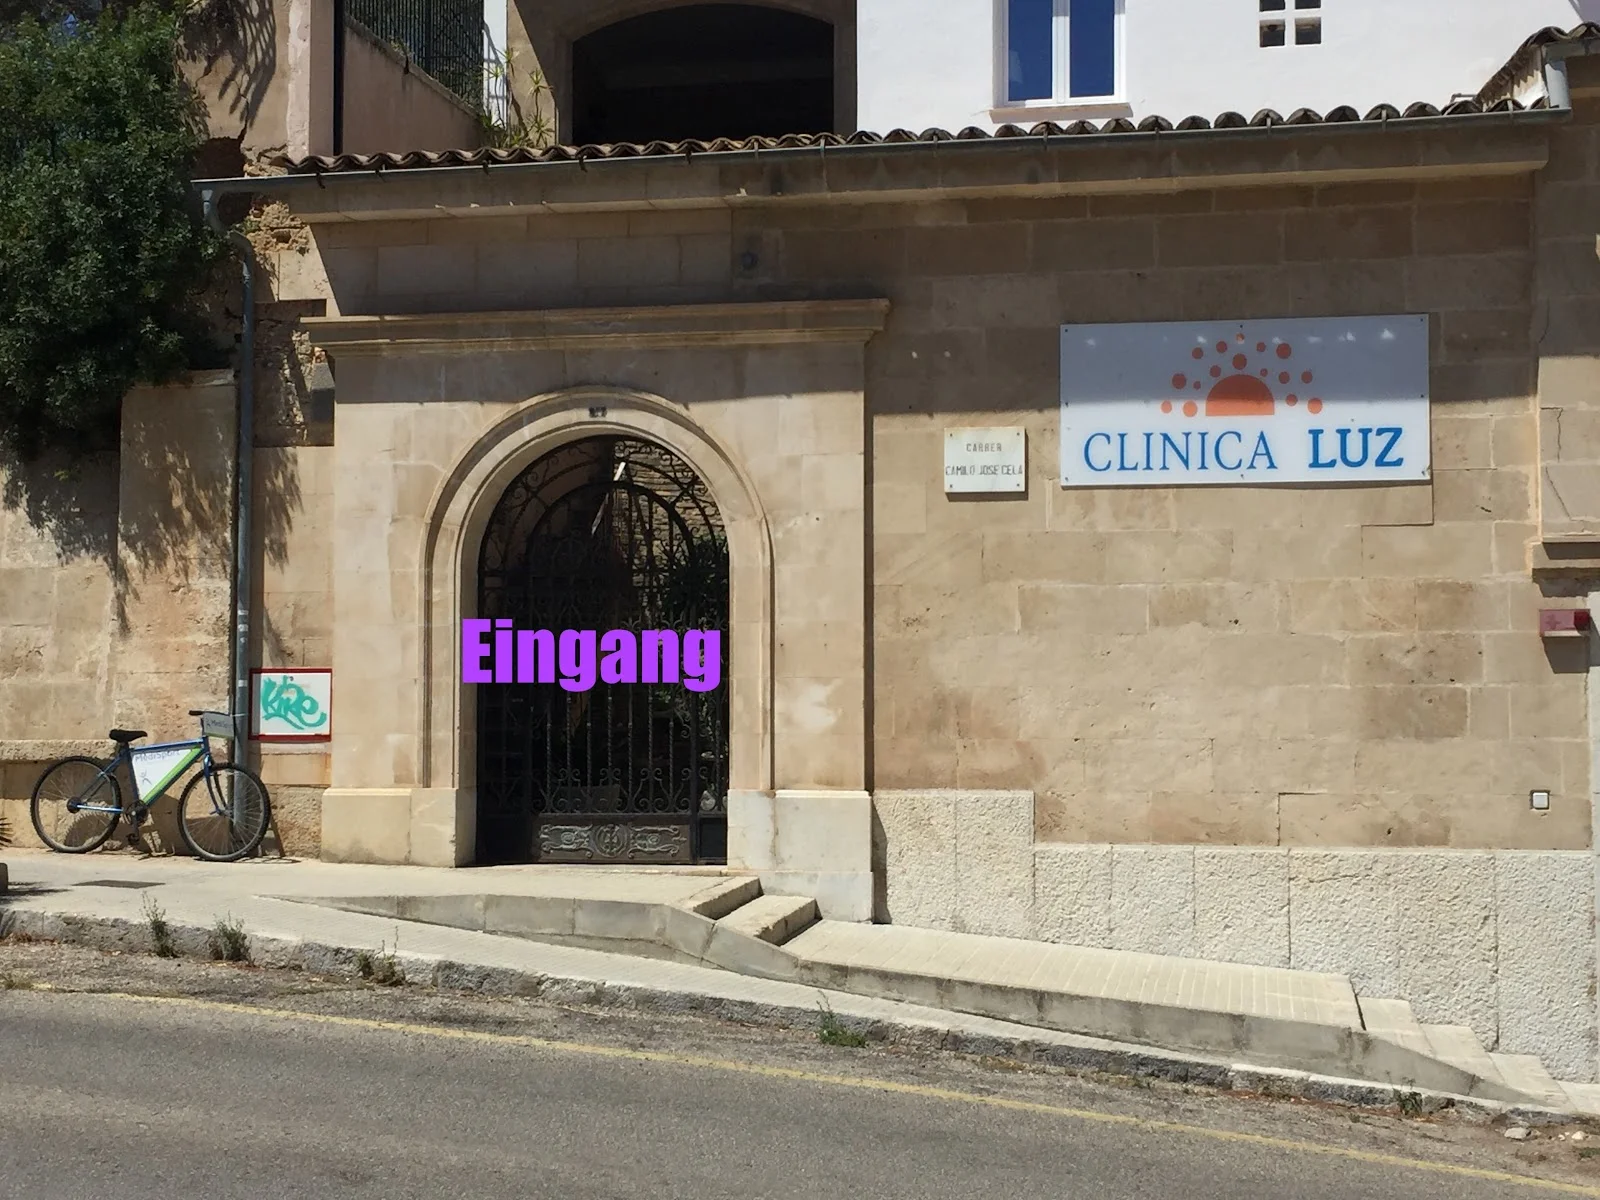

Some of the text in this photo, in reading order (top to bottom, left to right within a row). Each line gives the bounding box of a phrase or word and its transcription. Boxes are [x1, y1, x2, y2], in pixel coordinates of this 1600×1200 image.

[966, 443, 1002, 452] CARRER
[1083, 427, 1405, 472] CLINICA LUZ
[1001, 464, 1022, 475] CELA
